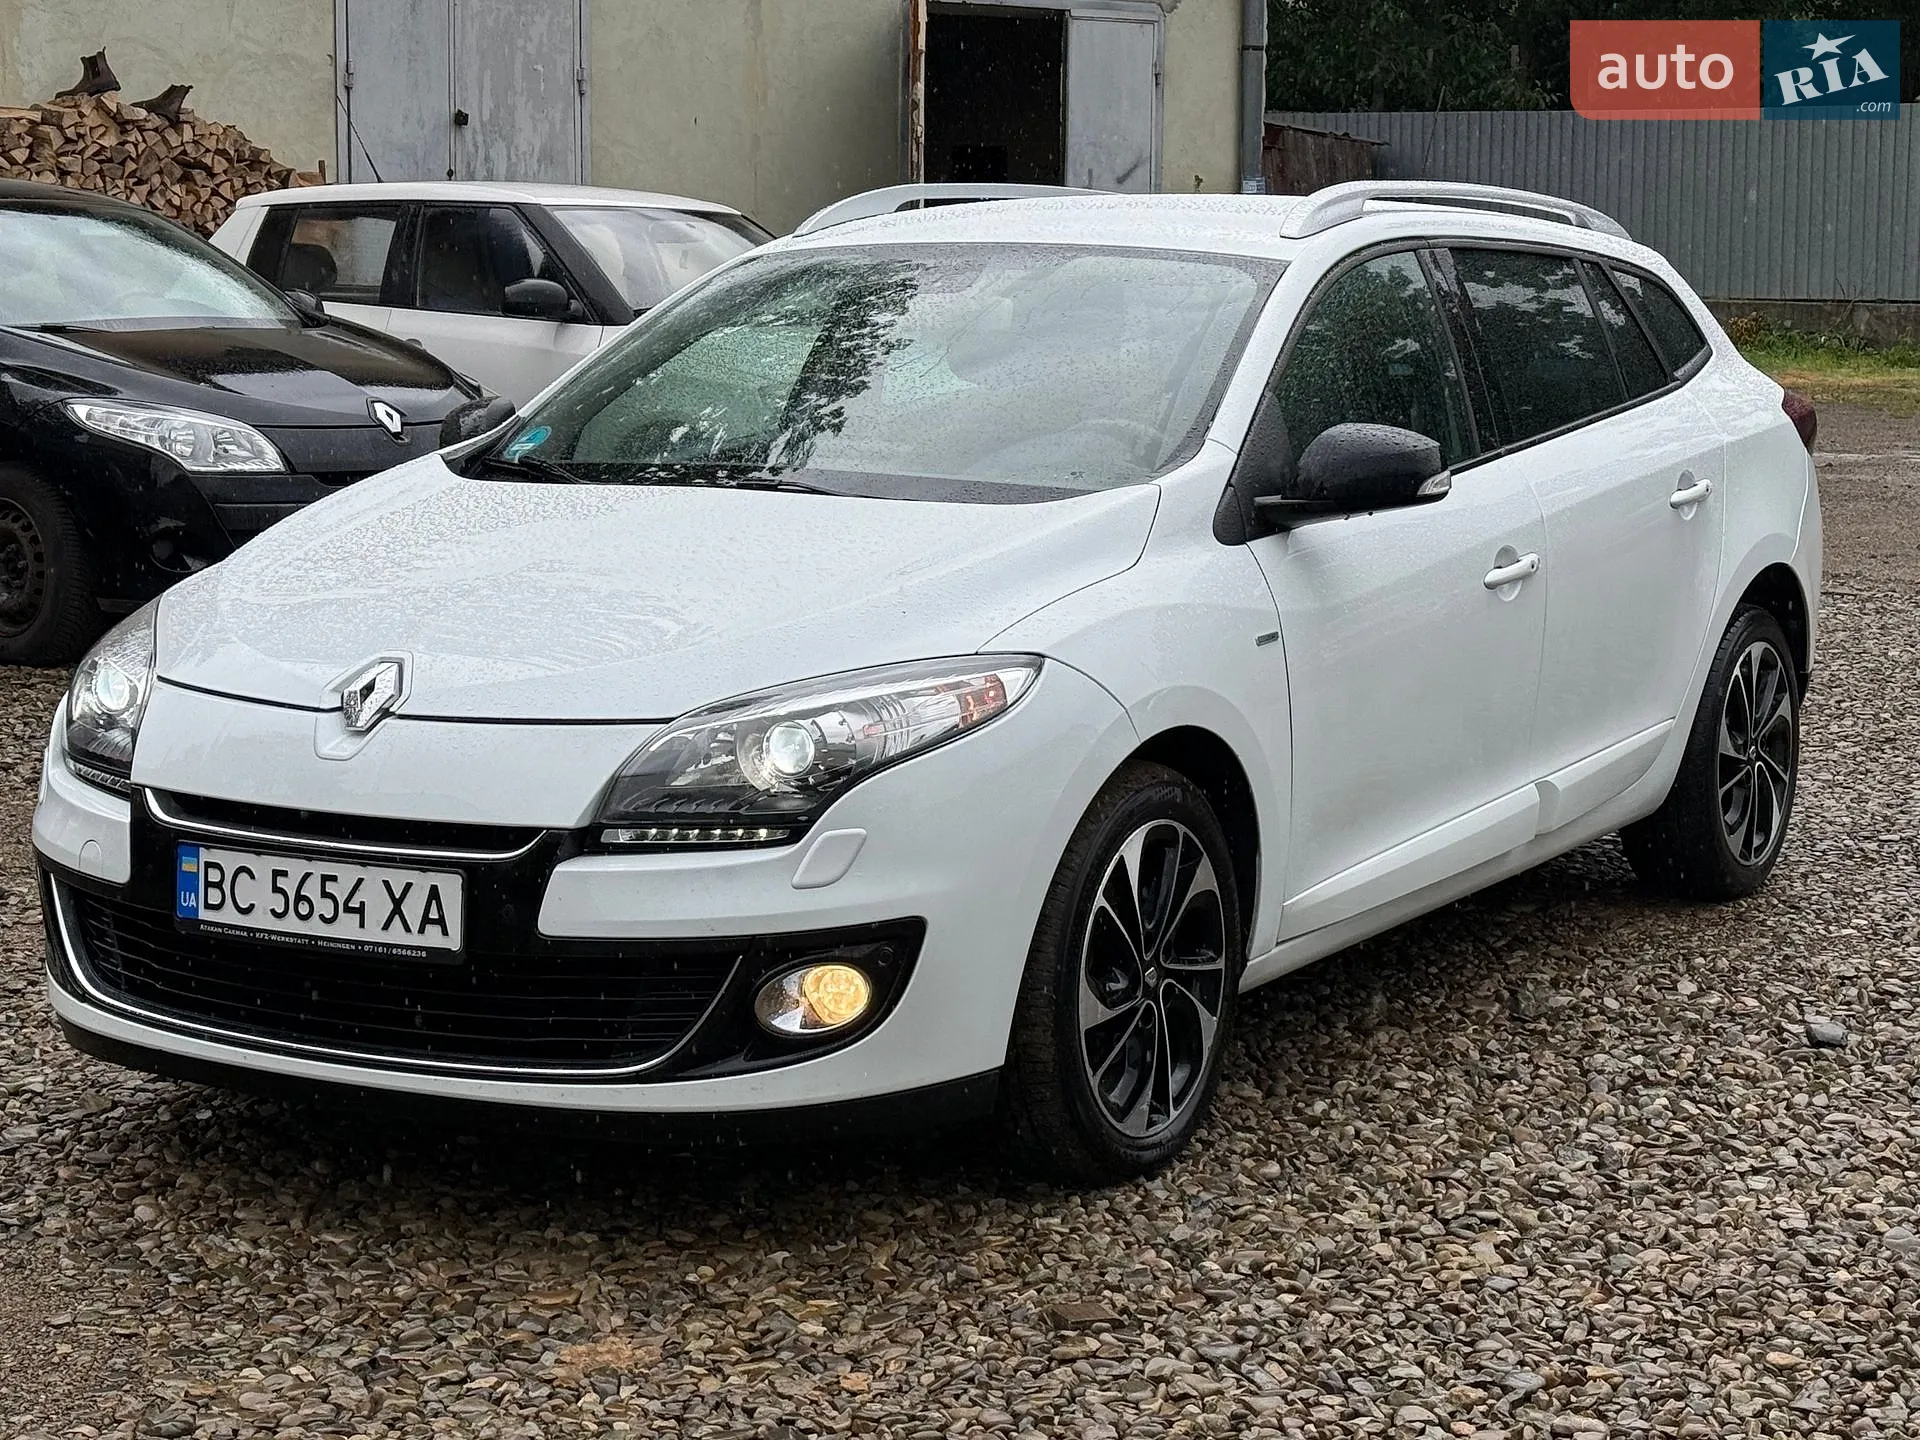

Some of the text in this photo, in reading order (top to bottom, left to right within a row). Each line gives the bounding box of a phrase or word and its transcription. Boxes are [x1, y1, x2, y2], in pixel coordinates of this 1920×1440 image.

[180, 891, 197, 908] UA
[203, 860, 449, 937] BC 5654 XA
